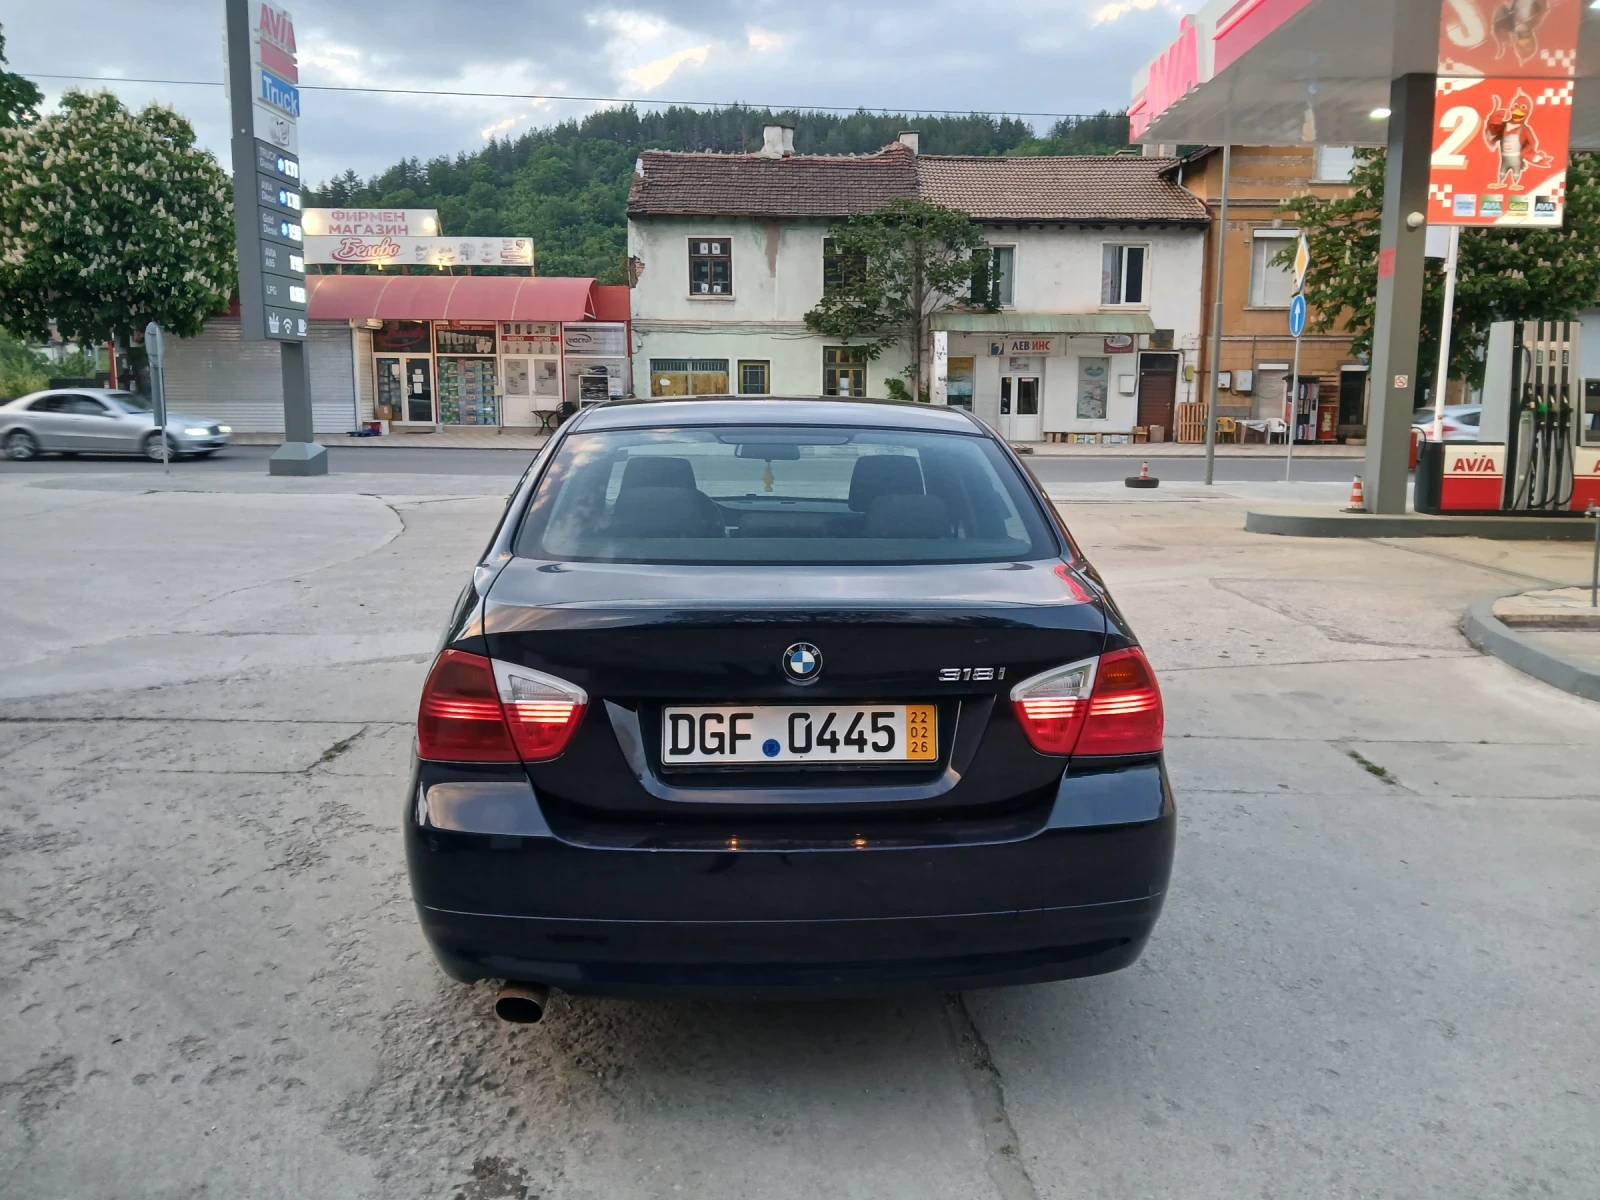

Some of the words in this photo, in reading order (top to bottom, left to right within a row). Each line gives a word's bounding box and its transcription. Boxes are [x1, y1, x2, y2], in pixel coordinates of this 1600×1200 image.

[263, 75, 298, 117] Truck
[1431, 106, 1480, 168] 2
[1482, 202, 1500, 210] AVIA
[1509, 202, 1527, 210] Gold
[1535, 203, 1554, 211] AVIA
[263, 213, 274, 224] Gold
[331, 211, 405, 223] ФИРМЕН
[328, 224, 408, 235] МАГАЗИН
[338, 236, 400, 258] Белово
[266, 285, 277, 295] LPG
[1012, 341, 1030, 351] ЛЕВ
[1032, 341, 1050, 351] ИНС
[1453, 455, 1495, 472] AVIA
[787, 644, 819, 657] BMW
[938, 667, 1006, 681] 318i
[910, 712, 928, 724] 22
[668, 712, 754, 756] DGF
[788, 711, 896, 754] 0445
[910, 726, 928, 738] 02
[911, 741, 928, 753] 26
